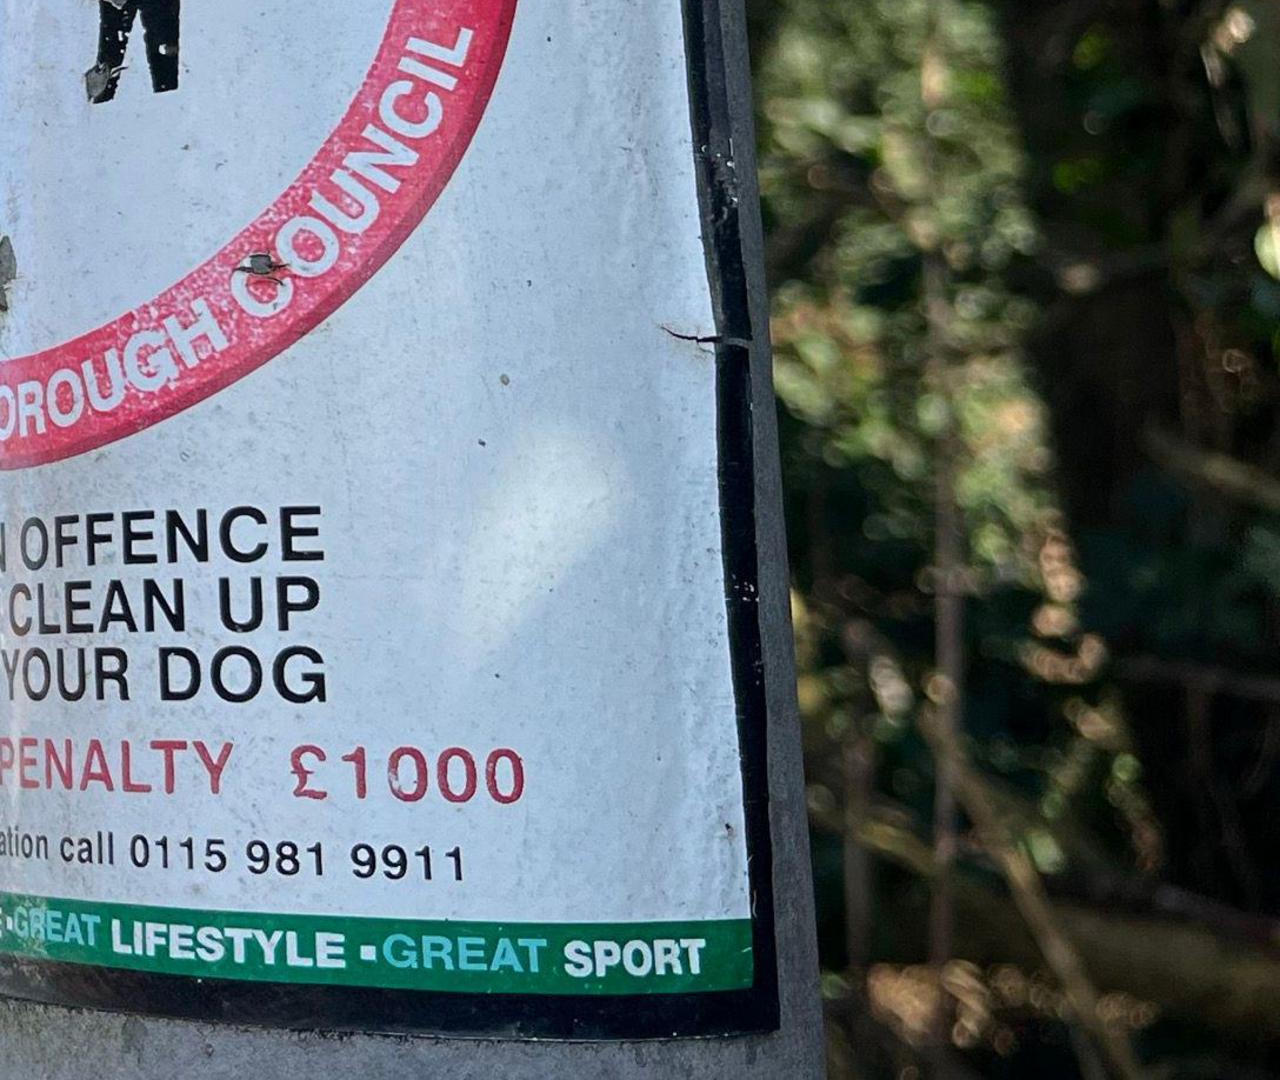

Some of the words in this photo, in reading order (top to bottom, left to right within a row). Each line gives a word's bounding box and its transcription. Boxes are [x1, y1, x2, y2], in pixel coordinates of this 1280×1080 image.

[231, 26, 474, 317] COUNCIL
[20, 505, 325, 571] OFFENCE
[9, 577, 185, 637] CLEAN
[219, 575, 320, 632] UP
[2, 647, 130, 702] YOUR
[159, 645, 328, 703] DOG
[290, 744, 525, 804] £1000
[60, 831, 114, 865] call
[130, 834, 227, 872] 0115
[246, 840, 324, 876] 981
[350, 844, 463, 881] 9911
[14, 905, 101, 947] GREAT
[111, 919, 346, 970] LIFESTYLE
[382, 933, 547, 974] GREAT
[563, 938, 707, 978] SPORT
